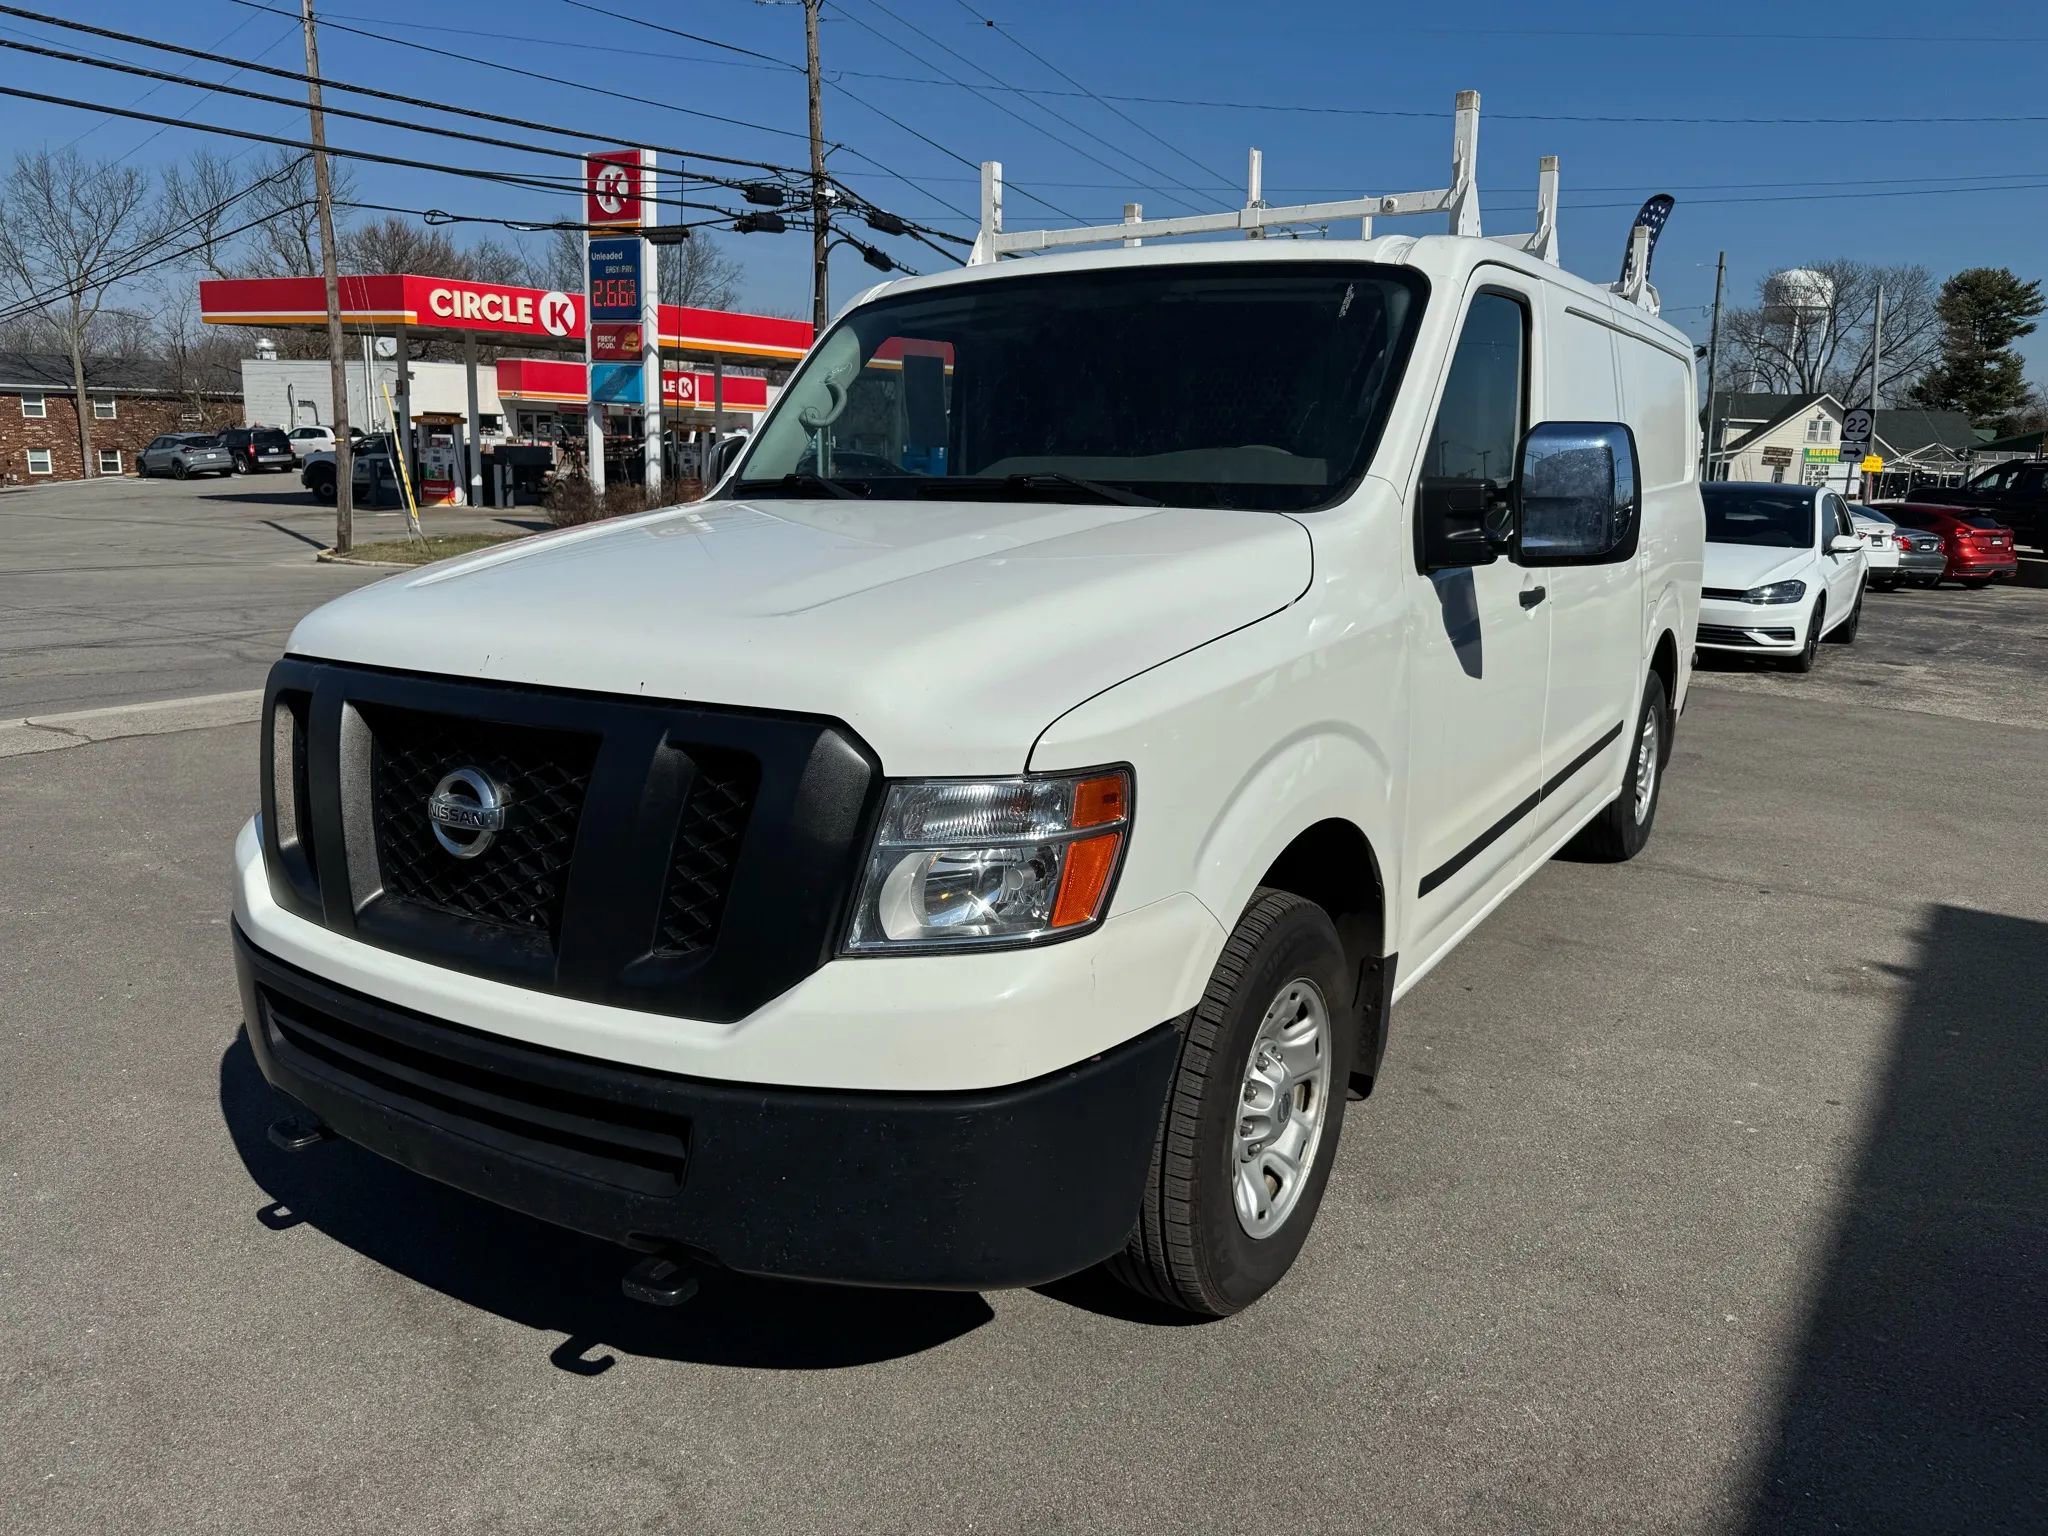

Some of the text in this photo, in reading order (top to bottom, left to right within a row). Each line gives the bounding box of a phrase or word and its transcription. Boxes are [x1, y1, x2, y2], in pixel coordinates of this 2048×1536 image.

[591, 251, 623, 261] Unleaded
[429, 288, 572, 334] CIRCLE K
[1845, 417, 1868, 433] 22
[429, 802, 485, 826] NISSAN
